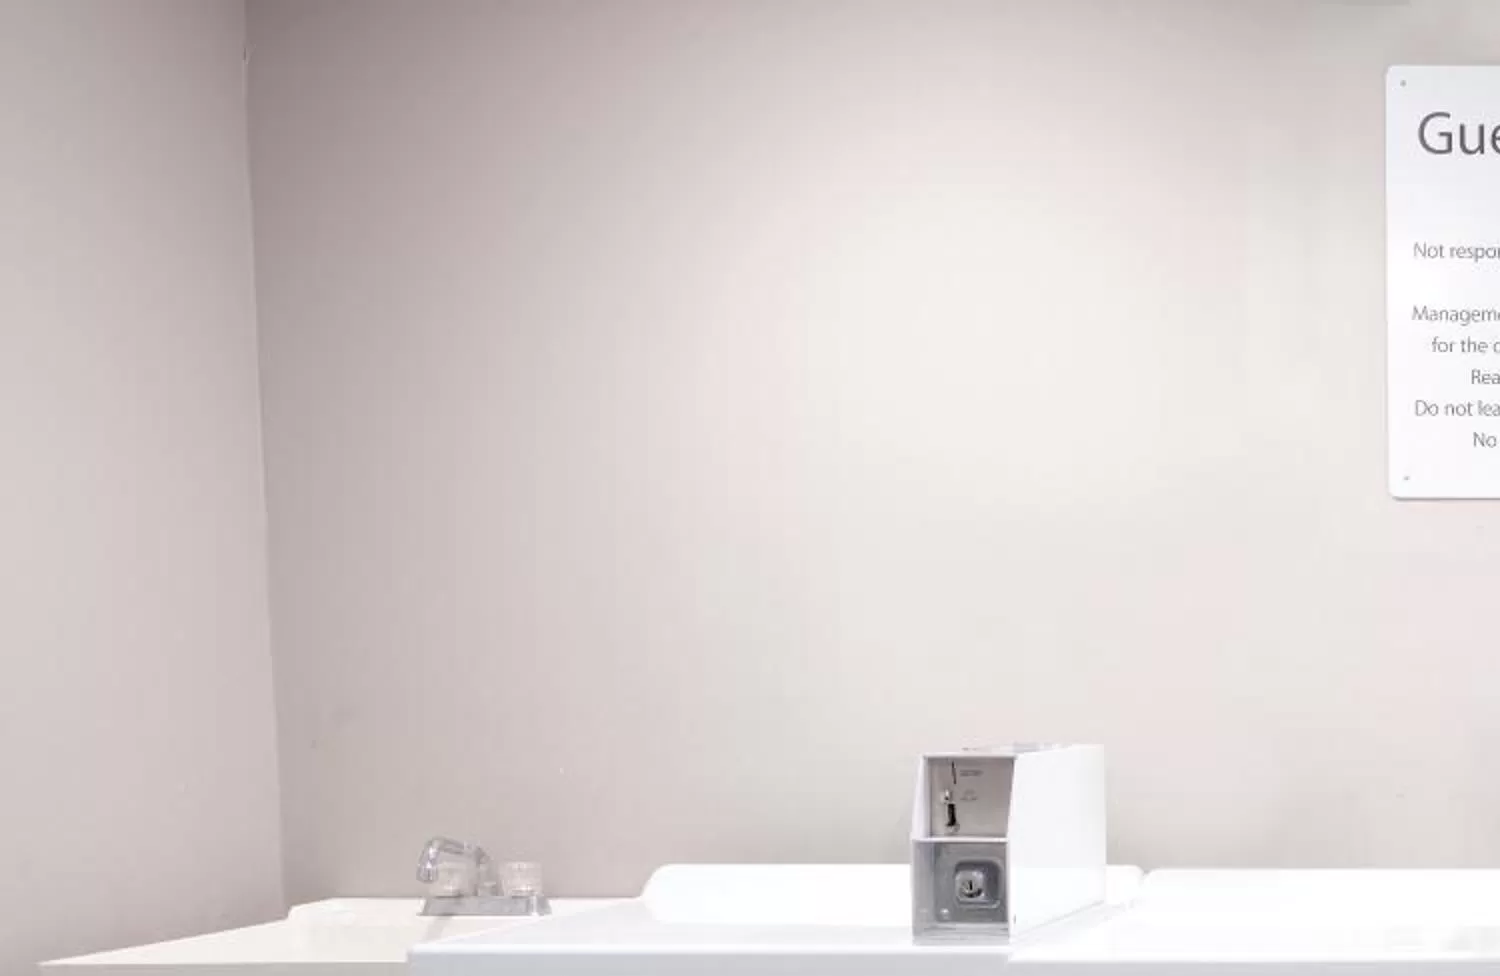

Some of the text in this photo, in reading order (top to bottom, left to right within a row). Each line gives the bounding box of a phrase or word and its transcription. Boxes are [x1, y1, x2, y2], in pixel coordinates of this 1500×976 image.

[1413, 241, 1445, 260] Not
[1431, 335, 1456, 353] for
[1459, 335, 1489, 354] the
[1414, 399, 1440, 417] Do
[1443, 401, 1474, 417] not
[1472, 431, 1497, 449] No
